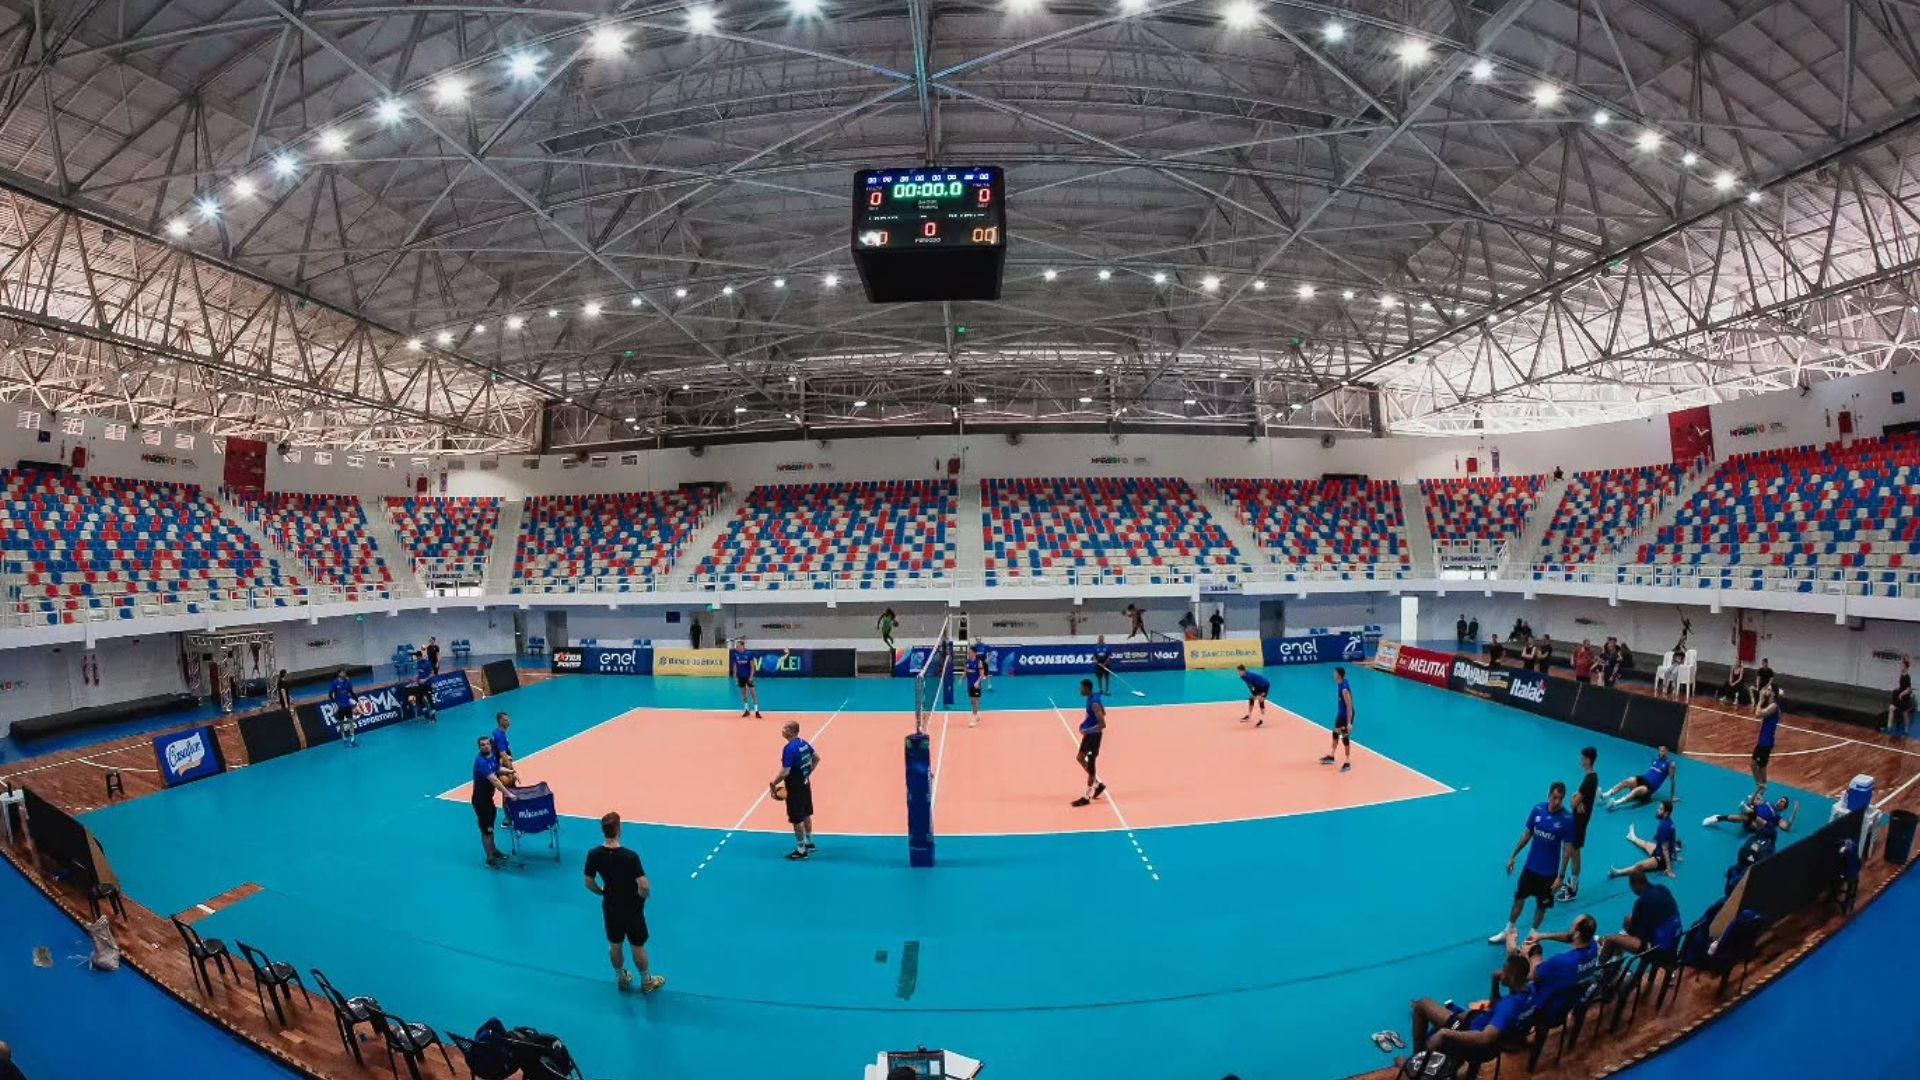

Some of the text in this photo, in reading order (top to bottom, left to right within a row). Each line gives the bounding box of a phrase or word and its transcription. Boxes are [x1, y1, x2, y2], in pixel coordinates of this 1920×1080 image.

[870, 192, 882, 205] 0
[979, 188, 990, 202] 0
[924, 222, 936, 236] 0
[1280, 638, 1318, 655] enel
[600, 649, 636, 665] enel
[1028, 654, 1094, 665] CONSIGAZ
[1408, 657, 1446, 678] MELITTA
[1509, 678, 1545, 703] Italac
